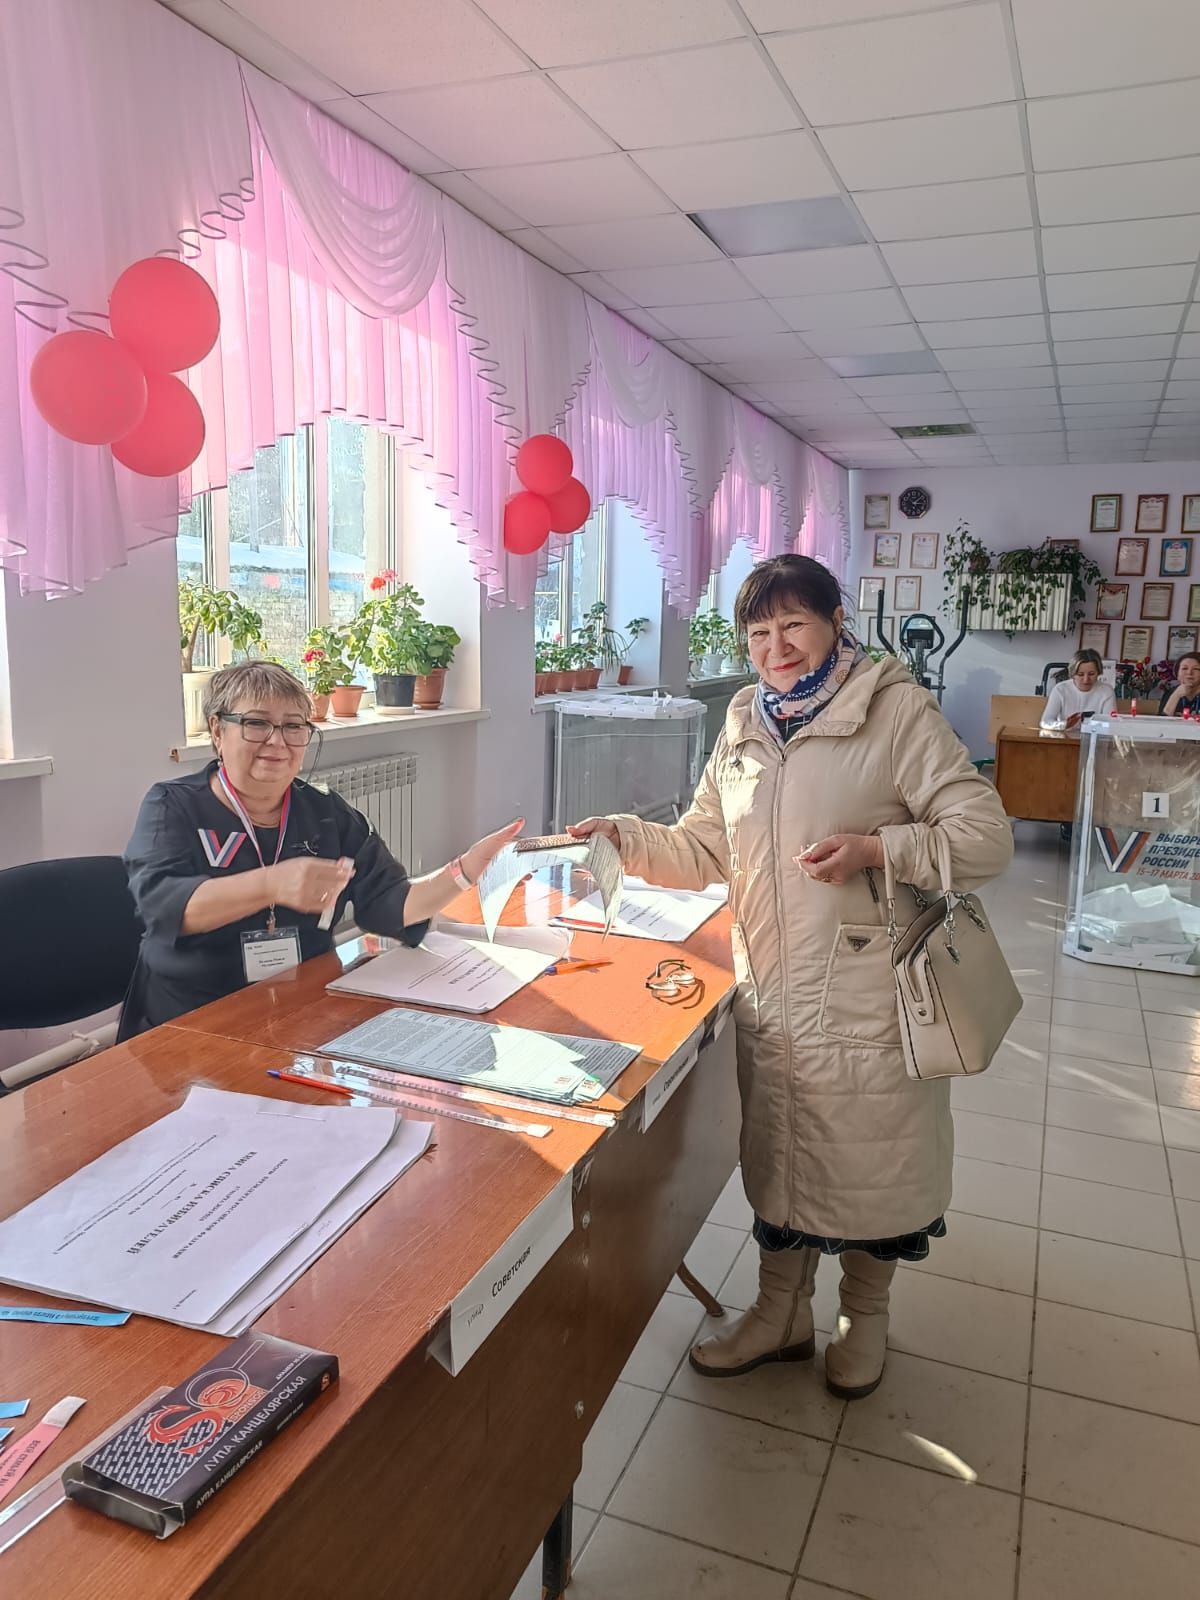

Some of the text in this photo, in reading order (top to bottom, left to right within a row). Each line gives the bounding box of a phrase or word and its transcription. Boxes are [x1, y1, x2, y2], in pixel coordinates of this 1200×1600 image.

[1152, 797, 1161, 814] 1
[1141, 856, 1190, 870] РОССИИ
[1159, 870, 1188, 880] МАРТА
[227, 1151, 257, 1170] КНИГА
[194, 1171, 231, 1200] СПИСКА
[126, 1200, 199, 1255] ИЗБИРАТЕЛЕЙ
[491, 1246, 531, 1297] Советская
[203, 1444, 236, 1472] ЛУПА
[231, 1375, 307, 1443] КАНЦЕЛЯРСКАЯ
[196, 1487, 215, 1508] ЛУПА
[215, 1439, 263, 1489] КАНЦЕЛЯРСКАЯ
